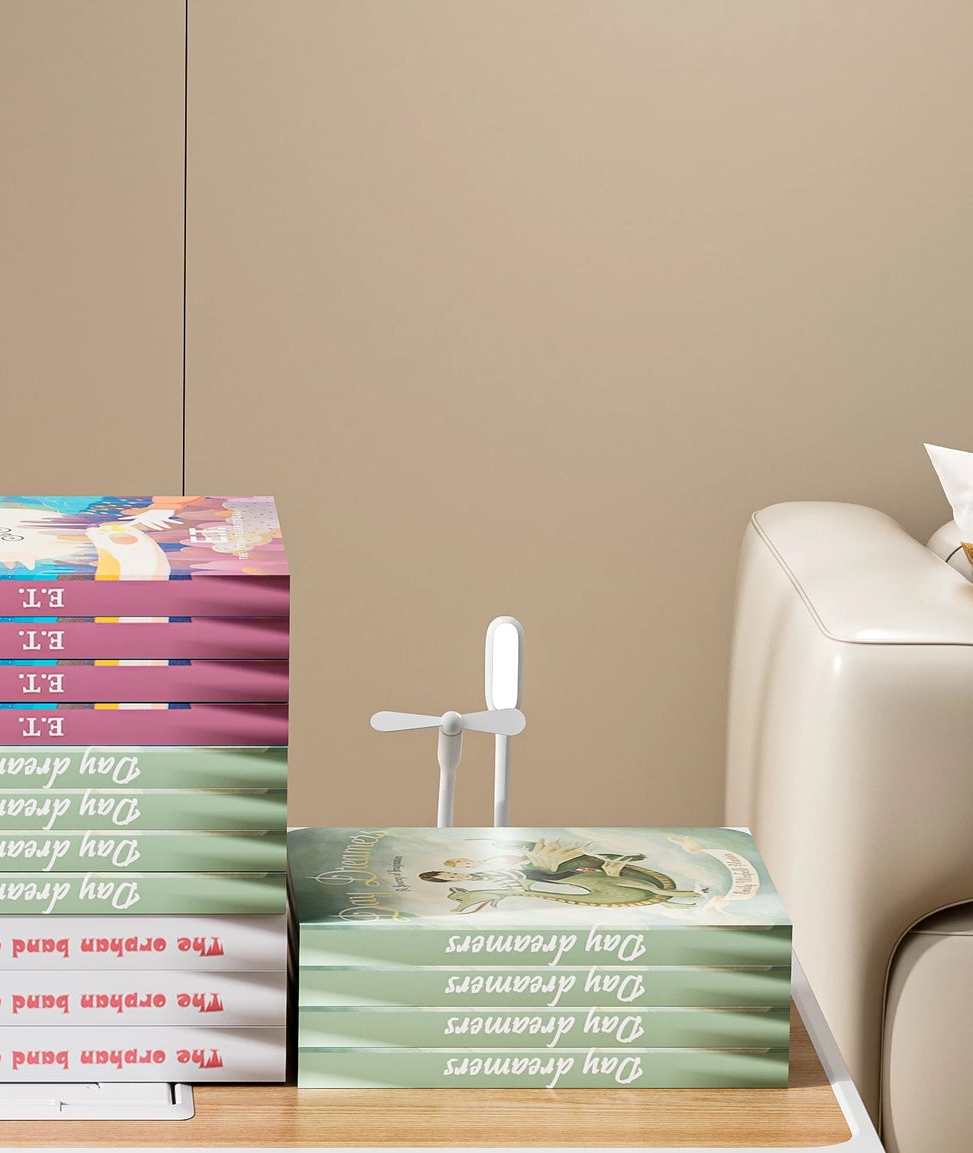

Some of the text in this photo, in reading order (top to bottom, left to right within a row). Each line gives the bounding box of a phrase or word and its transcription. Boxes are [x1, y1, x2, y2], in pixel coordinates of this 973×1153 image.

[18, 588, 65, 608] E.T.
[18, 630, 65, 651] E.T.
[18, 673, 65, 694] E.T.
[18, 717, 65, 737] E.T.
[80, 747, 140, 784] Day
[80, 789, 140, 826] Day
[80, 830, 140, 867] Day
[305, 830, 410, 922] Day Dreamers
[80, 872, 140, 908] Day
[11, 938, 70, 959] band
[80, 936, 167, 958] orphan
[176, 936, 225, 958] The
[446, 923, 646, 966] Day dreamers
[445, 966, 645, 1006] Day dreamers
[11, 994, 70, 1015] band
[79, 992, 167, 1014] orphan
[176, 992, 225, 1014] The
[444, 1007, 644, 1047] Day dreamers
[11, 1050, 70, 1071] band
[80, 1048, 167, 1070] orphan
[176, 1048, 224, 1070] The
[443, 1048, 643, 1088] Day dreamers
